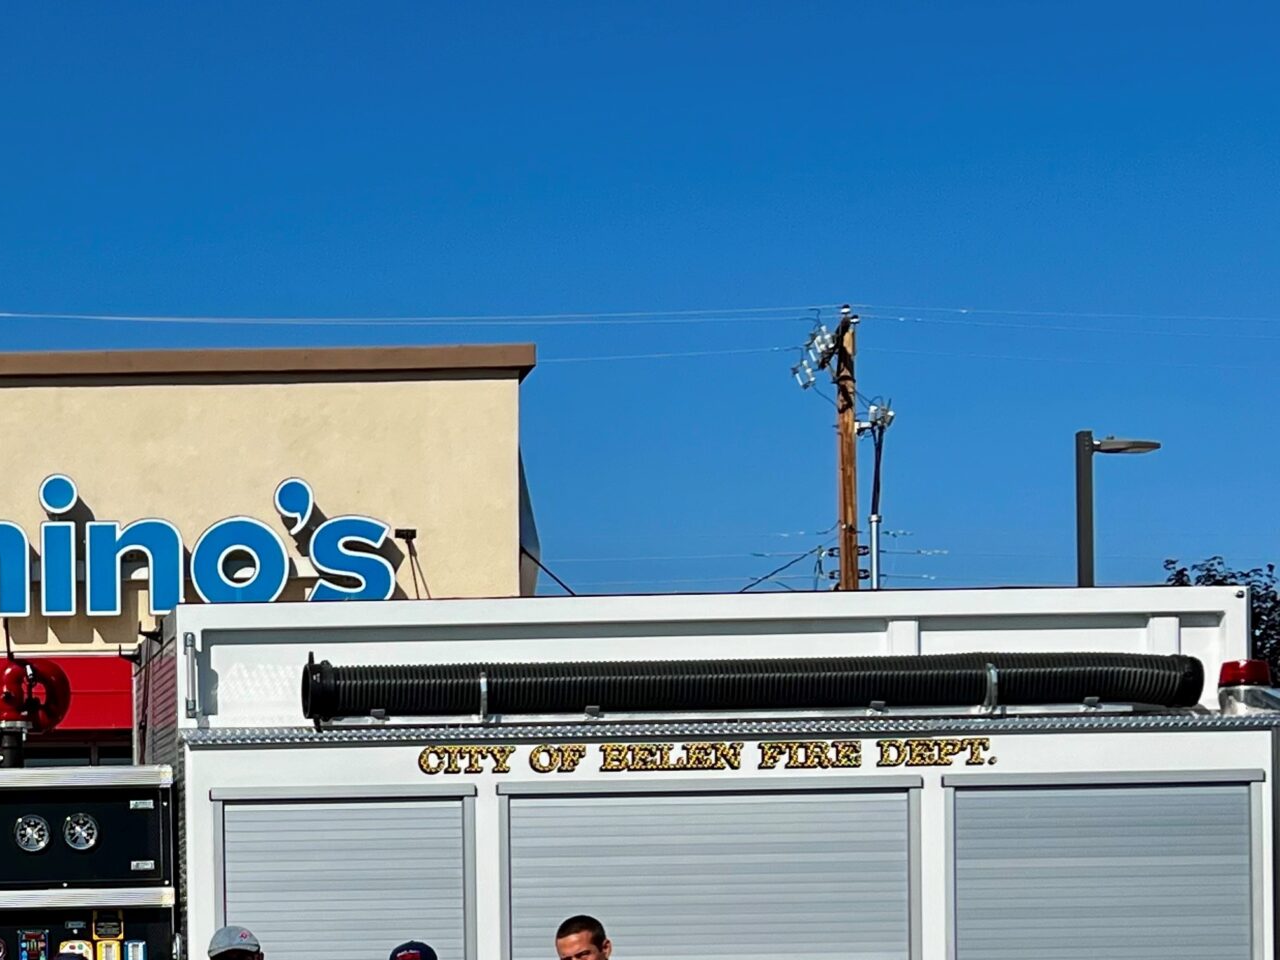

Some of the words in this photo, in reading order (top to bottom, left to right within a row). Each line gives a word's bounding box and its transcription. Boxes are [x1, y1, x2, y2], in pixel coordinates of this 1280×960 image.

[418, 744, 515, 774] CITY
[529, 743, 586, 773] OF
[600, 741, 744, 771] BELEN
[758, 740, 862, 769] FIRE
[876, 738, 998, 768] DEPT.
